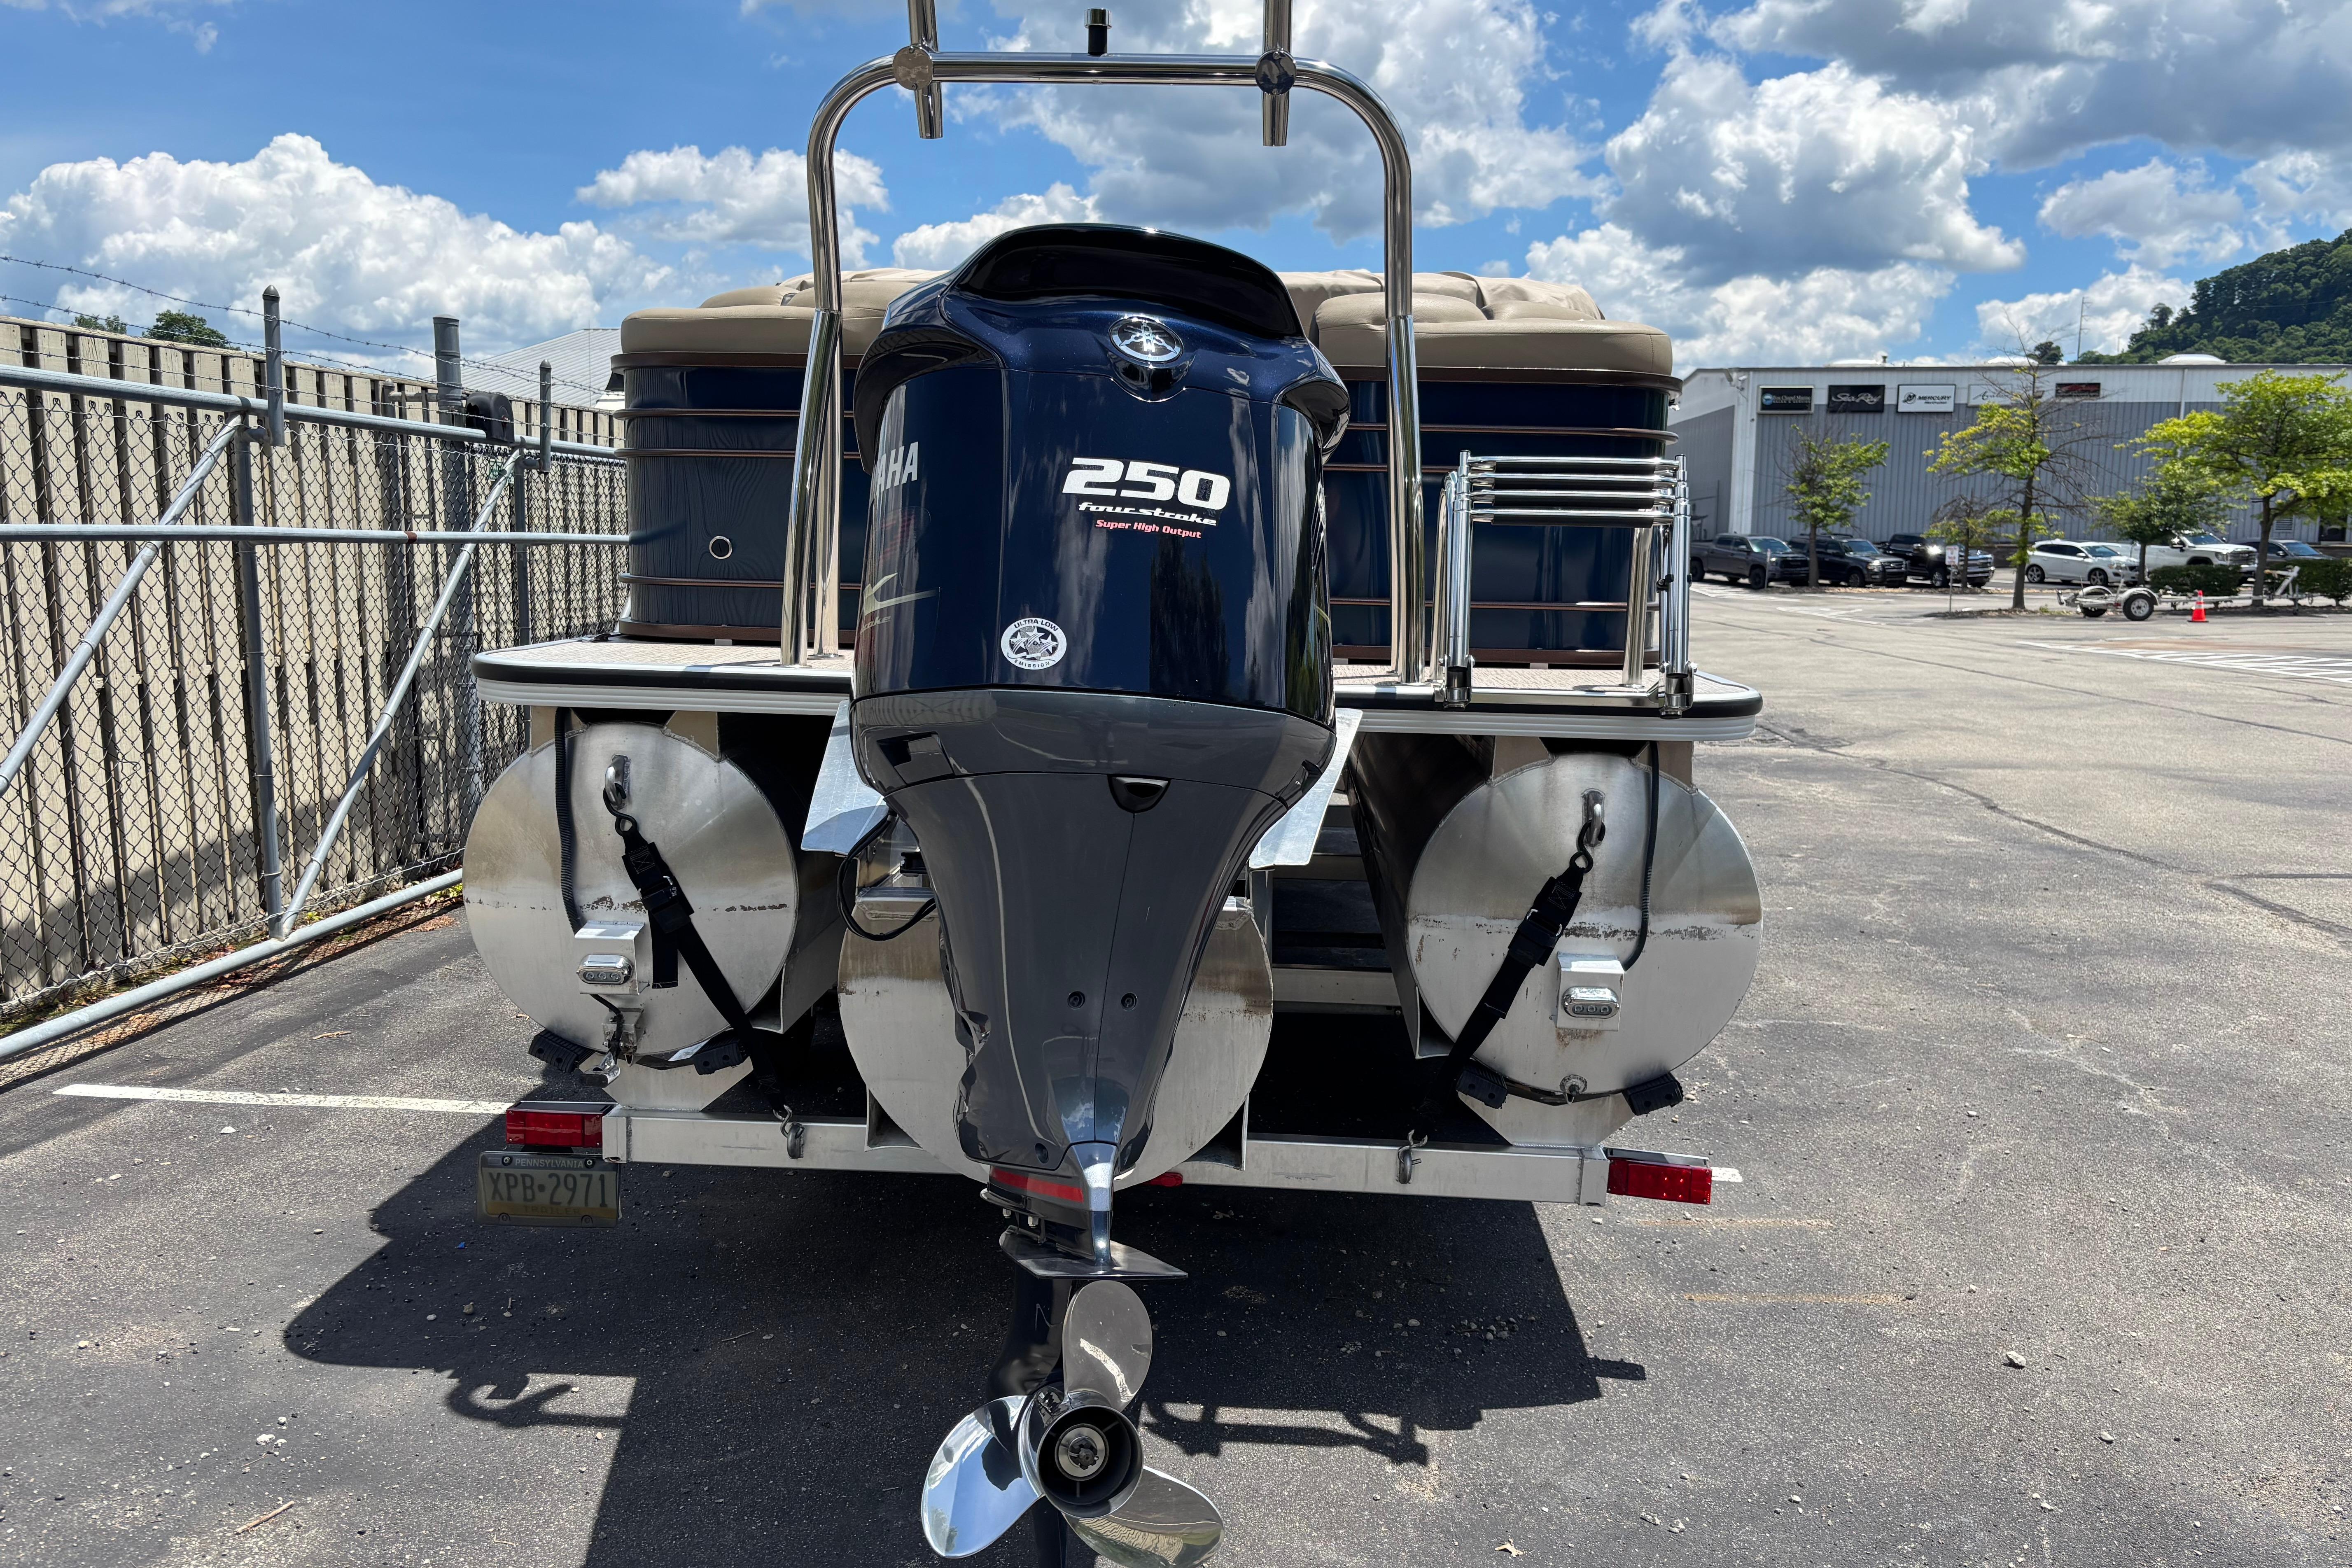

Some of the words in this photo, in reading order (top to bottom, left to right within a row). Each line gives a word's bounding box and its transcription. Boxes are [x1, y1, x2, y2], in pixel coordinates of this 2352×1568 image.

[1832, 392, 1855, 402] Sea
[1062, 457, 1230, 510] 250
[1095, 520, 1131, 530] Super
[1134, 523, 1159, 532] High
[1162, 526, 1202, 539] Output
[1014, 659, 1050, 668] EMISSION
[515, 1157, 584, 1169] PENNSYLVANIA
[523, 1205, 581, 1215] TRAILER
